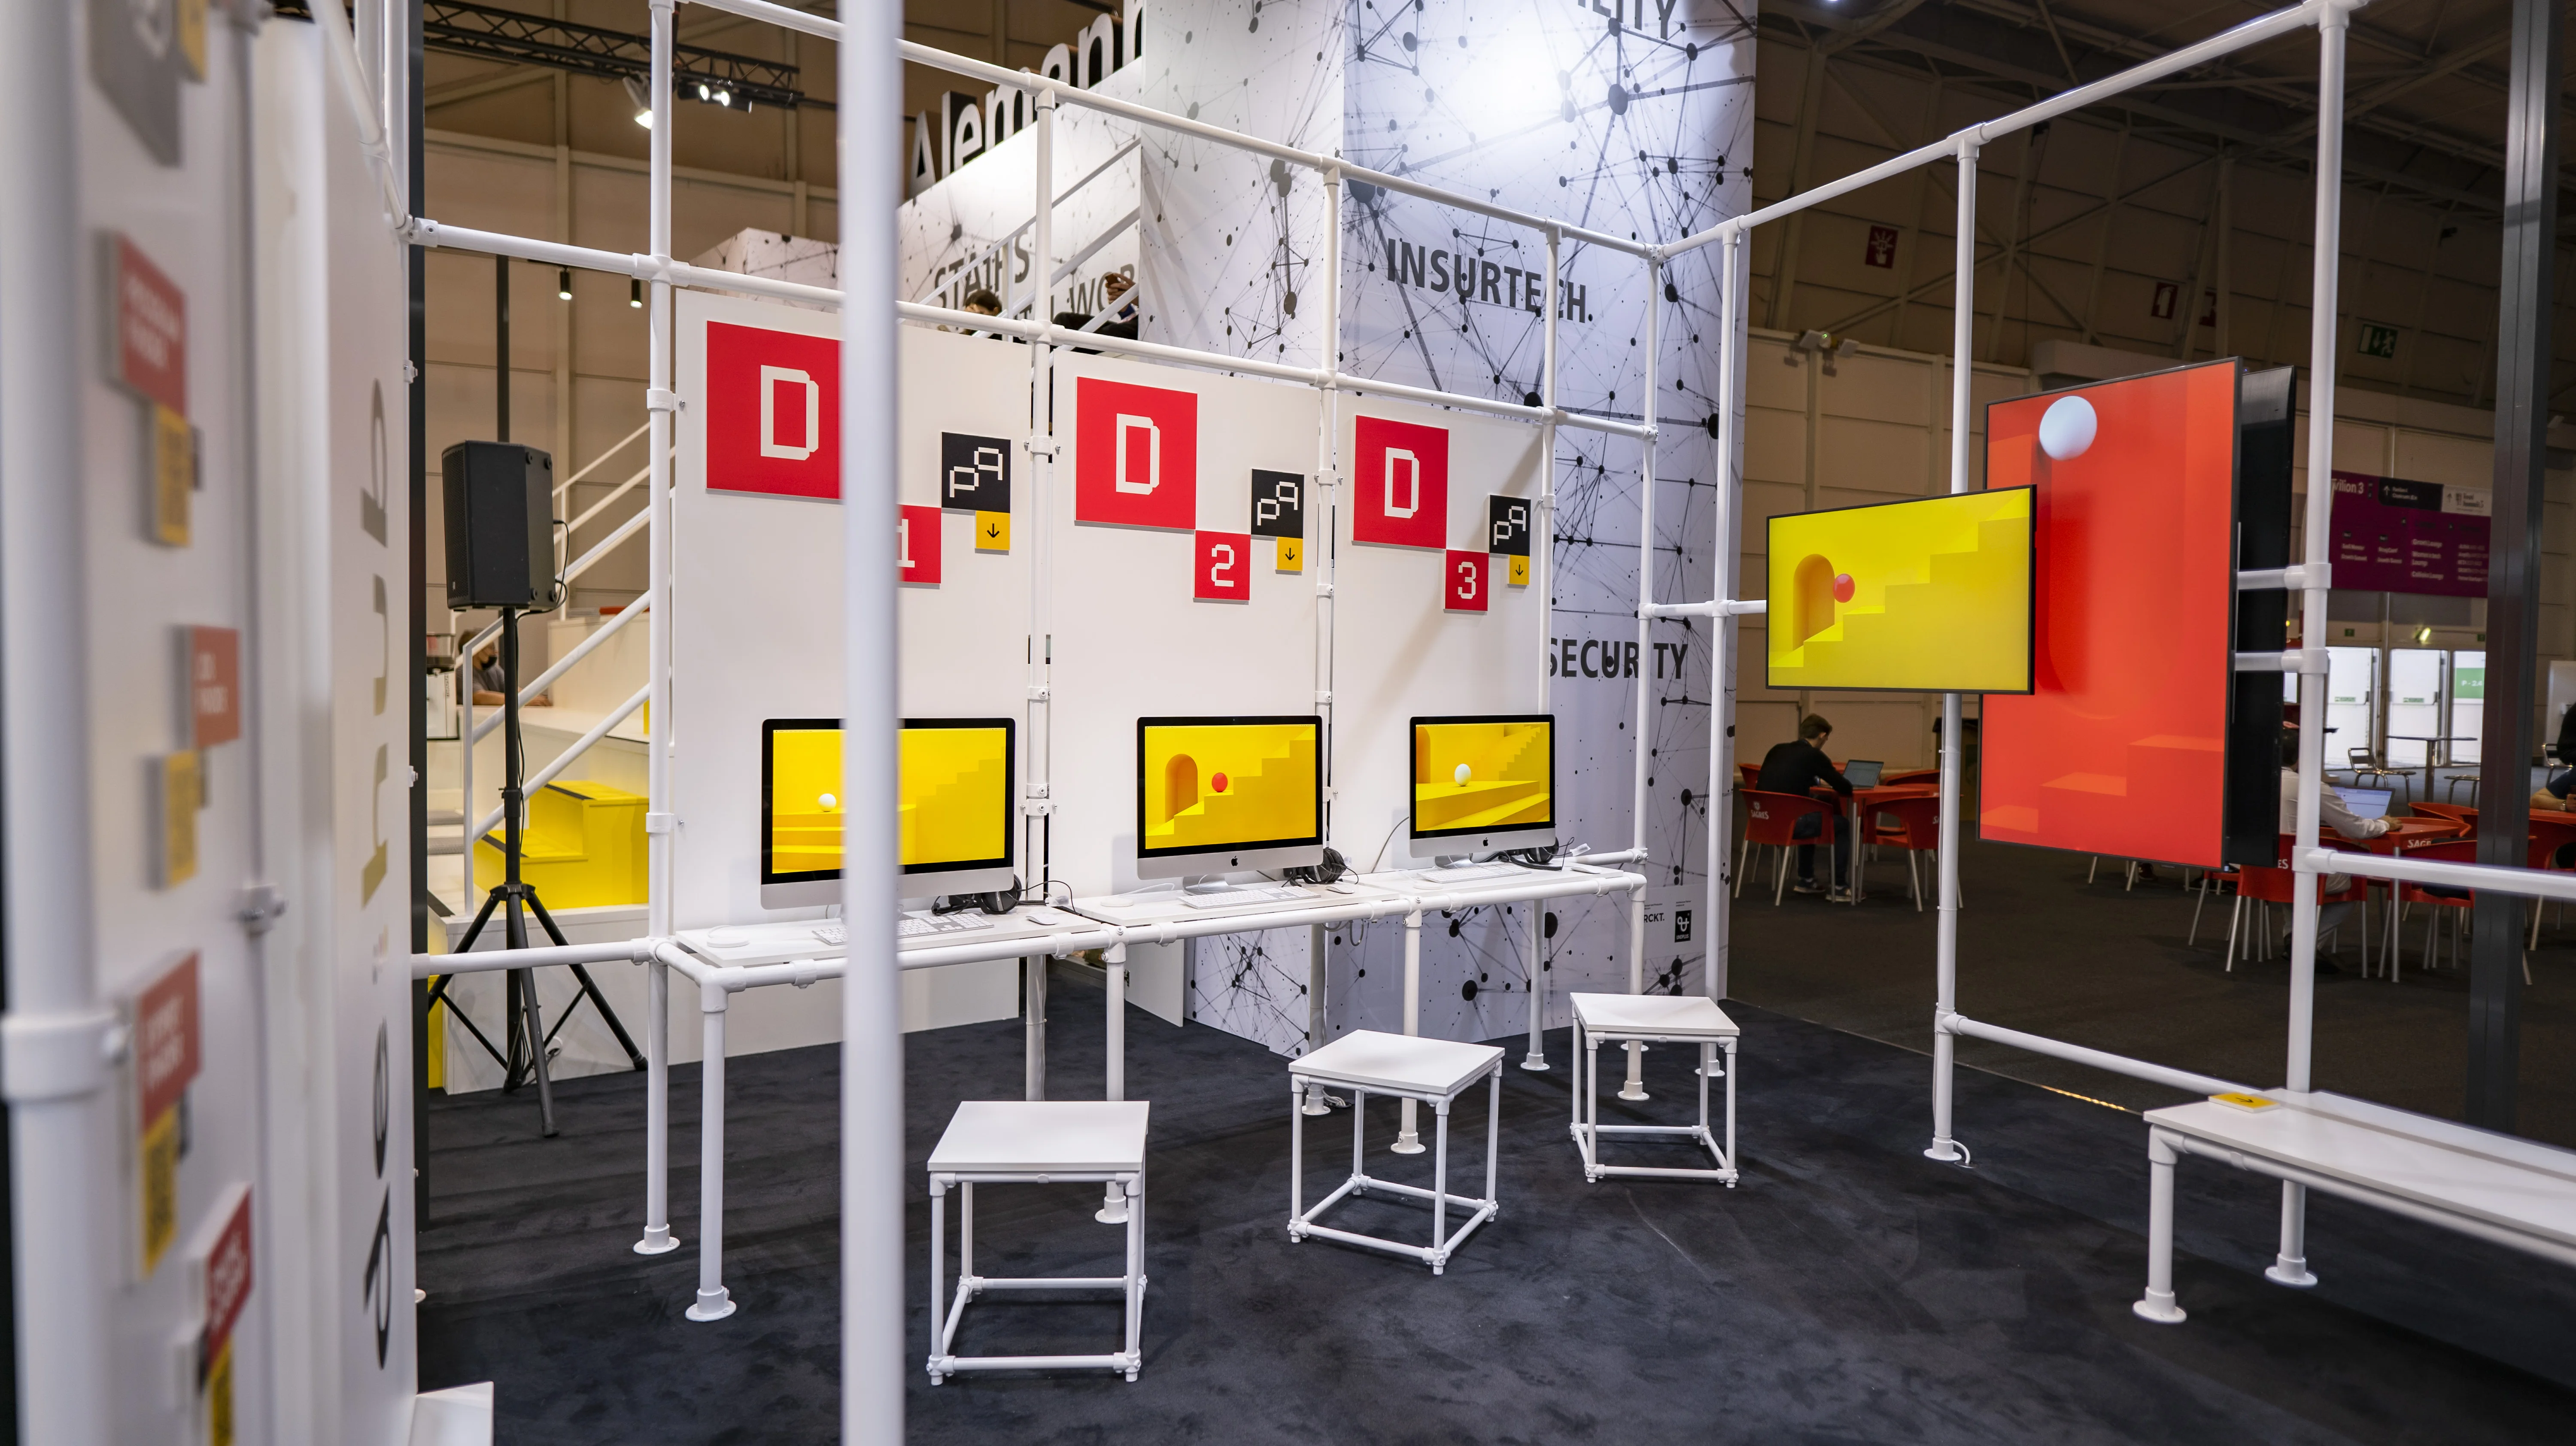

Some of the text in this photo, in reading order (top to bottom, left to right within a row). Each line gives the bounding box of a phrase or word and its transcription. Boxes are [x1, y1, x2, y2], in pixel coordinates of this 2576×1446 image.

[1388, 238, 1586, 323] INSURTEH
[760, 365, 819, 461] D
[1116, 413, 1160, 495] D
[1385, 447, 1419, 519] D
[2358, 481, 2364, 495] 3
[1211, 544, 1234, 586] 2
[1458, 562, 1476, 599] 3
[1550, 637, 1688, 679] SECURTY
